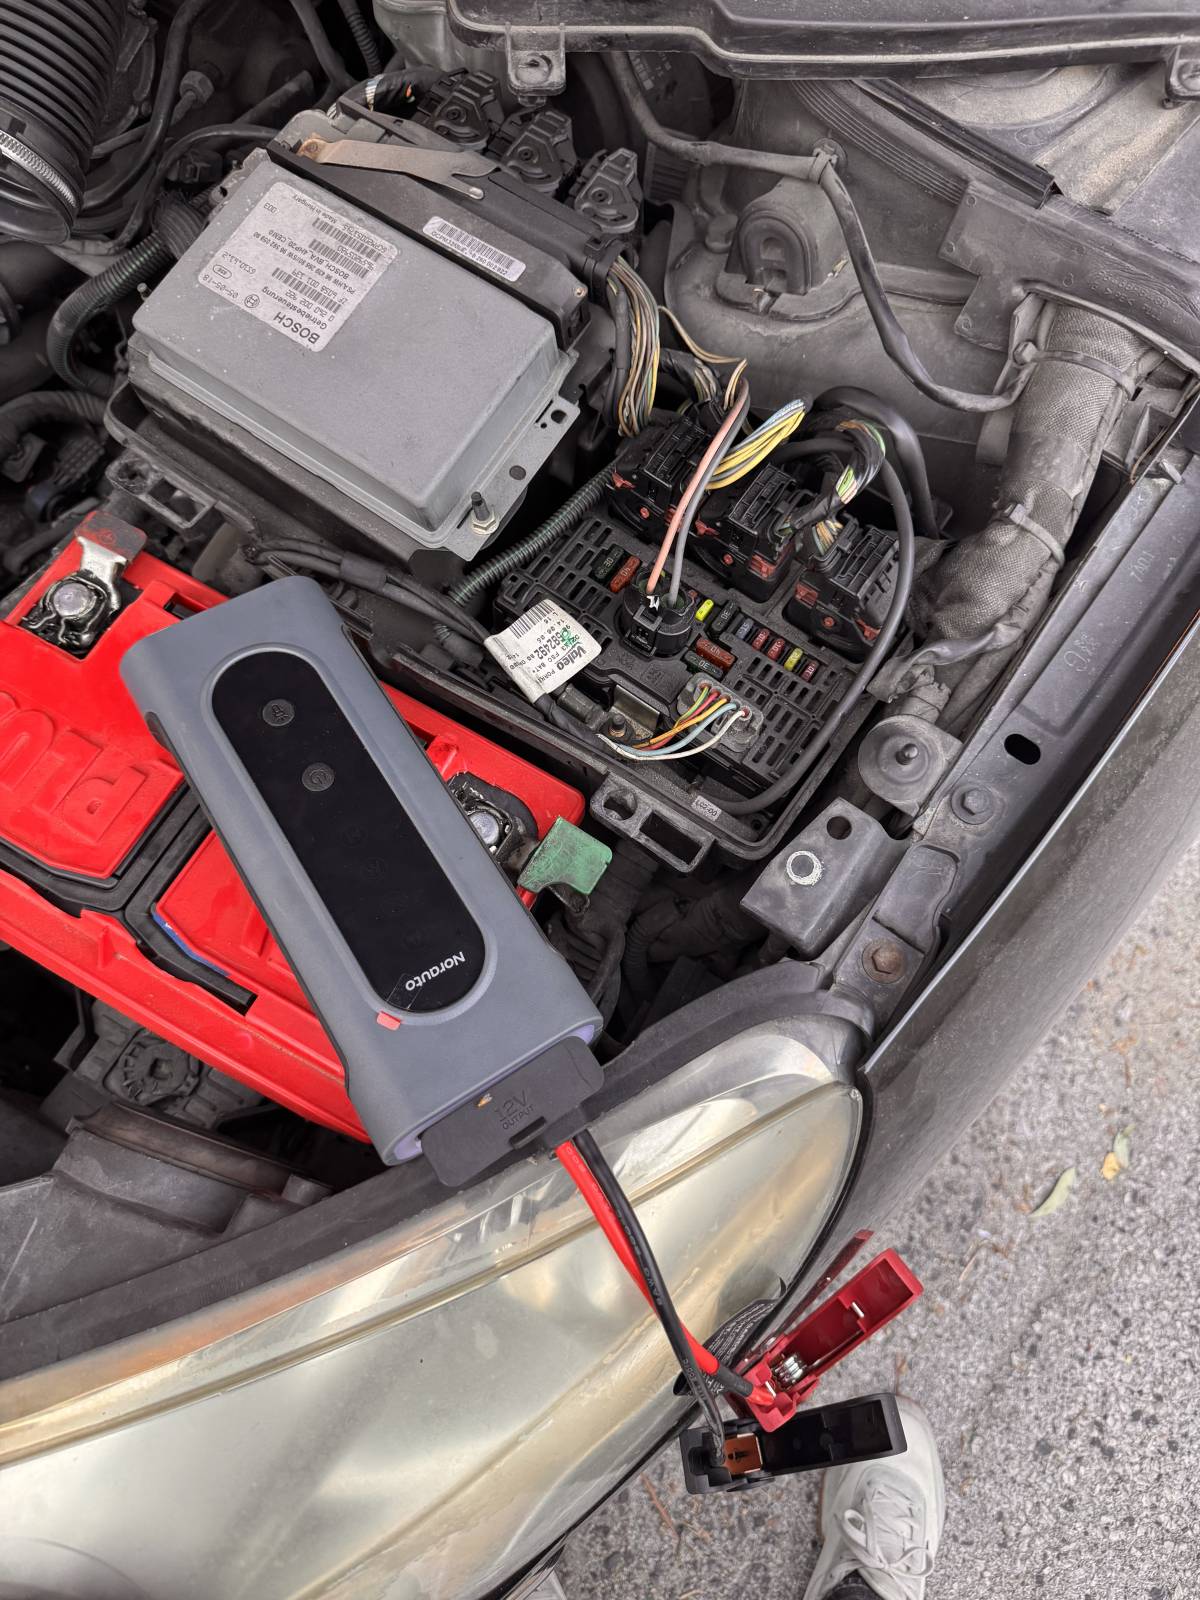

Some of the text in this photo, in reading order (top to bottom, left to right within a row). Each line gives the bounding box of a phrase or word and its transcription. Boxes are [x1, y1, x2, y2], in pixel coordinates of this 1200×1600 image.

[261, 286, 328, 329] Getriebesteuerung
[273, 311, 320, 344] BOSCH
[556, 645, 586, 671] Valeo
[405, 952, 466, 991] Norauto
[503, 1104, 534, 1130] OUTPUT
